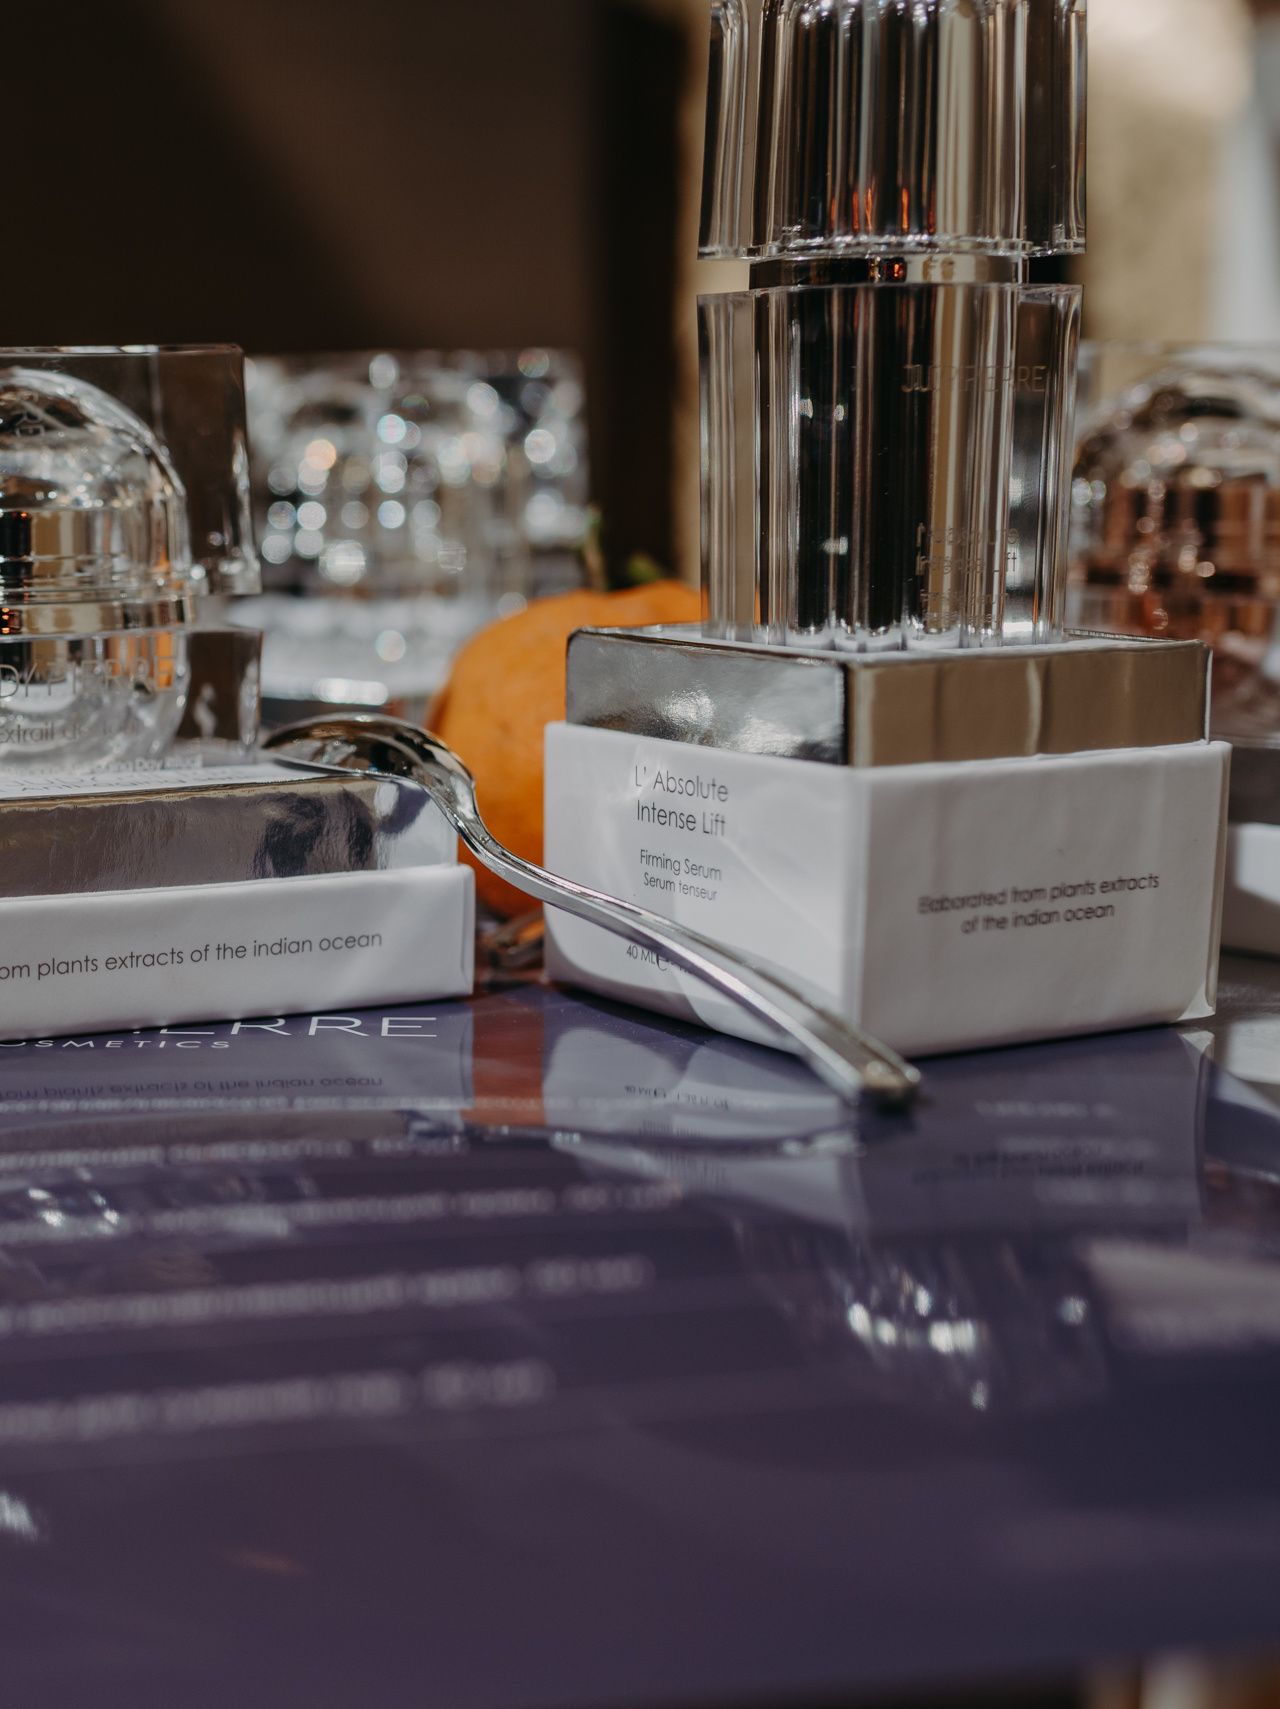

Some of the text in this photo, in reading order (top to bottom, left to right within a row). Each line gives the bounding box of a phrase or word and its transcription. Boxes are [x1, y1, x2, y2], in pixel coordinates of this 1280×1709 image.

[652, 769, 729, 803] Absolute
[637, 799, 726, 837] Intense Lift
[639, 848, 723, 882] Firming Serum
[643, 871, 718, 901] Serum tenseur
[917, 872, 1160, 915] Elaborated from plants extracts
[960, 903, 1115, 935] of the indian ocean
[37, 954, 99, 981] plants
[104, 947, 185, 971] extracts
[190, 943, 211, 963] of
[215, 942, 247, 961] the
[252, 937, 313, 957] indian
[318, 932, 383, 951] ocean
[626, 943, 639, 960] 40
